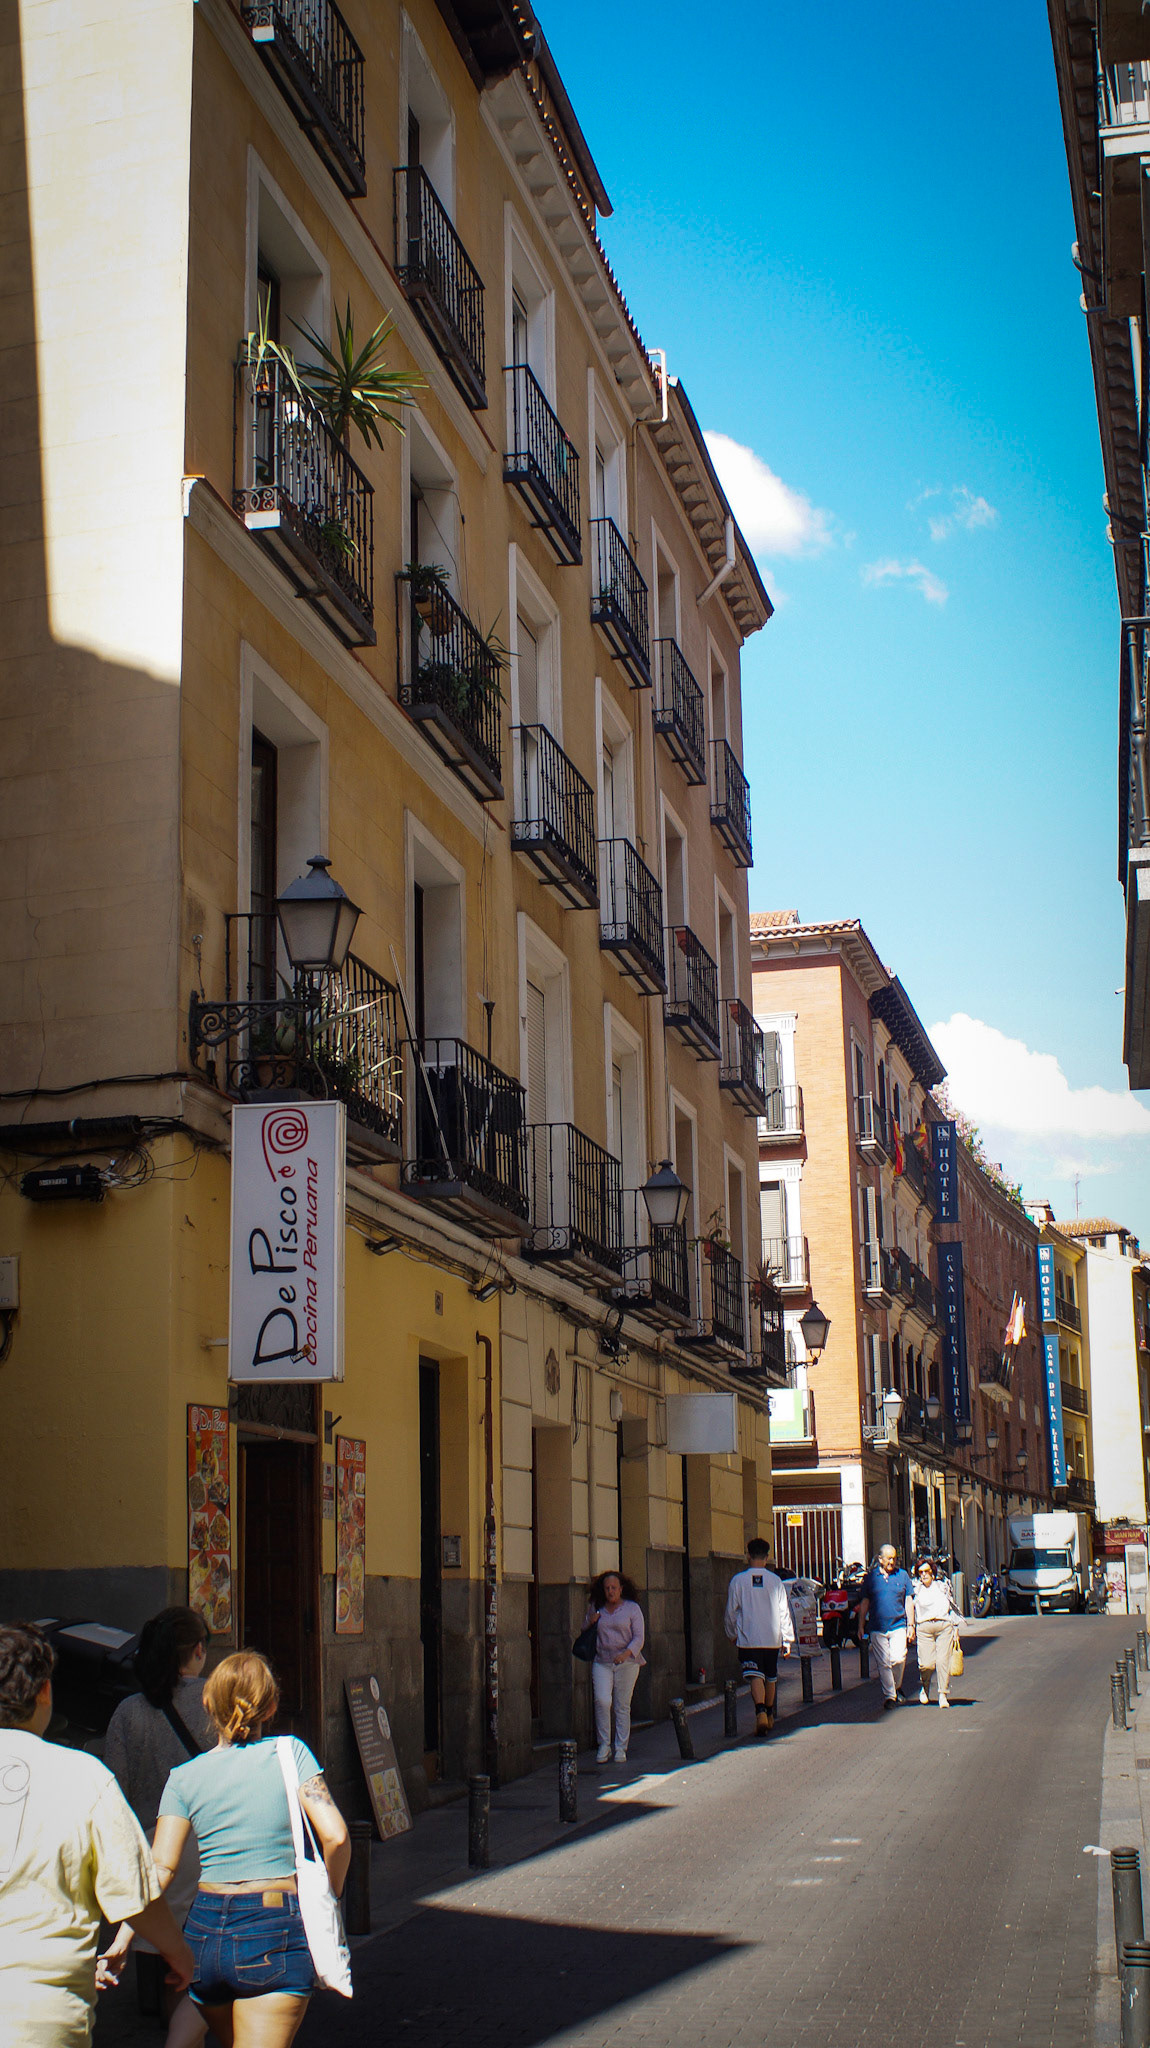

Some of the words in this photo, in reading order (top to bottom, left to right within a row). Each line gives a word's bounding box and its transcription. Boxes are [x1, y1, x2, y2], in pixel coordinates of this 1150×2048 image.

[939, 1148, 950, 1217] HOTEL
[248, 1185, 298, 1276] Pisco
[303, 1157, 319, 1273] Peruana
[946, 1254, 955, 1293] CASA
[1041, 1264, 1051, 1318] HOTEL
[252, 1285, 298, 1367] De
[303, 1277, 318, 1367] Cocina
[949, 1304, 956, 1324] DE
[950, 1335, 958, 1355] LA
[1046, 1344, 1054, 1374] CASA
[1048, 1381, 1056, 1398] DE
[199, 1408, 212, 1430] De
[212, 1408, 227, 1431] Pisco
[1050, 1404, 1057, 1421] LA
